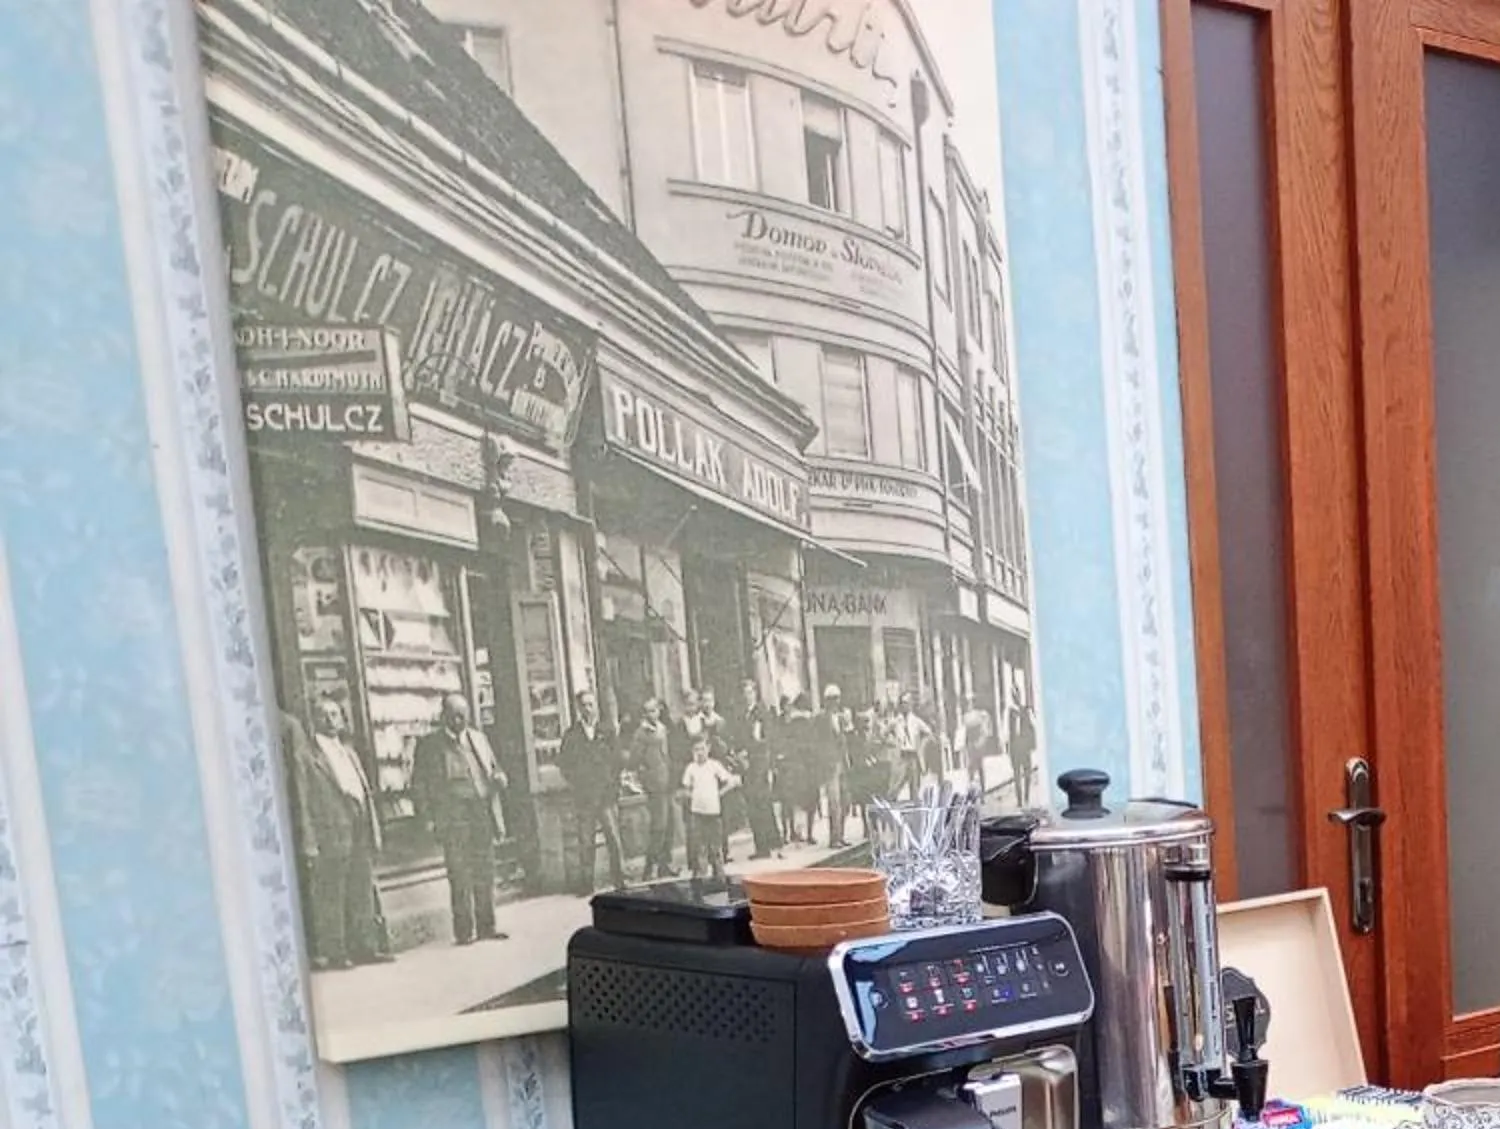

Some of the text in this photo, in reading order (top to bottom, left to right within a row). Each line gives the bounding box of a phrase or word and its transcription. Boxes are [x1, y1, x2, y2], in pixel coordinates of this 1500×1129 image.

[231, 190, 412, 323] SCHULCZ
[236, 327, 365, 350] OH-I-NOOR
[247, 402, 383, 433] SCHULCZ
[613, 384, 727, 491] POLLAK
[743, 456, 800, 521] ADOLF
